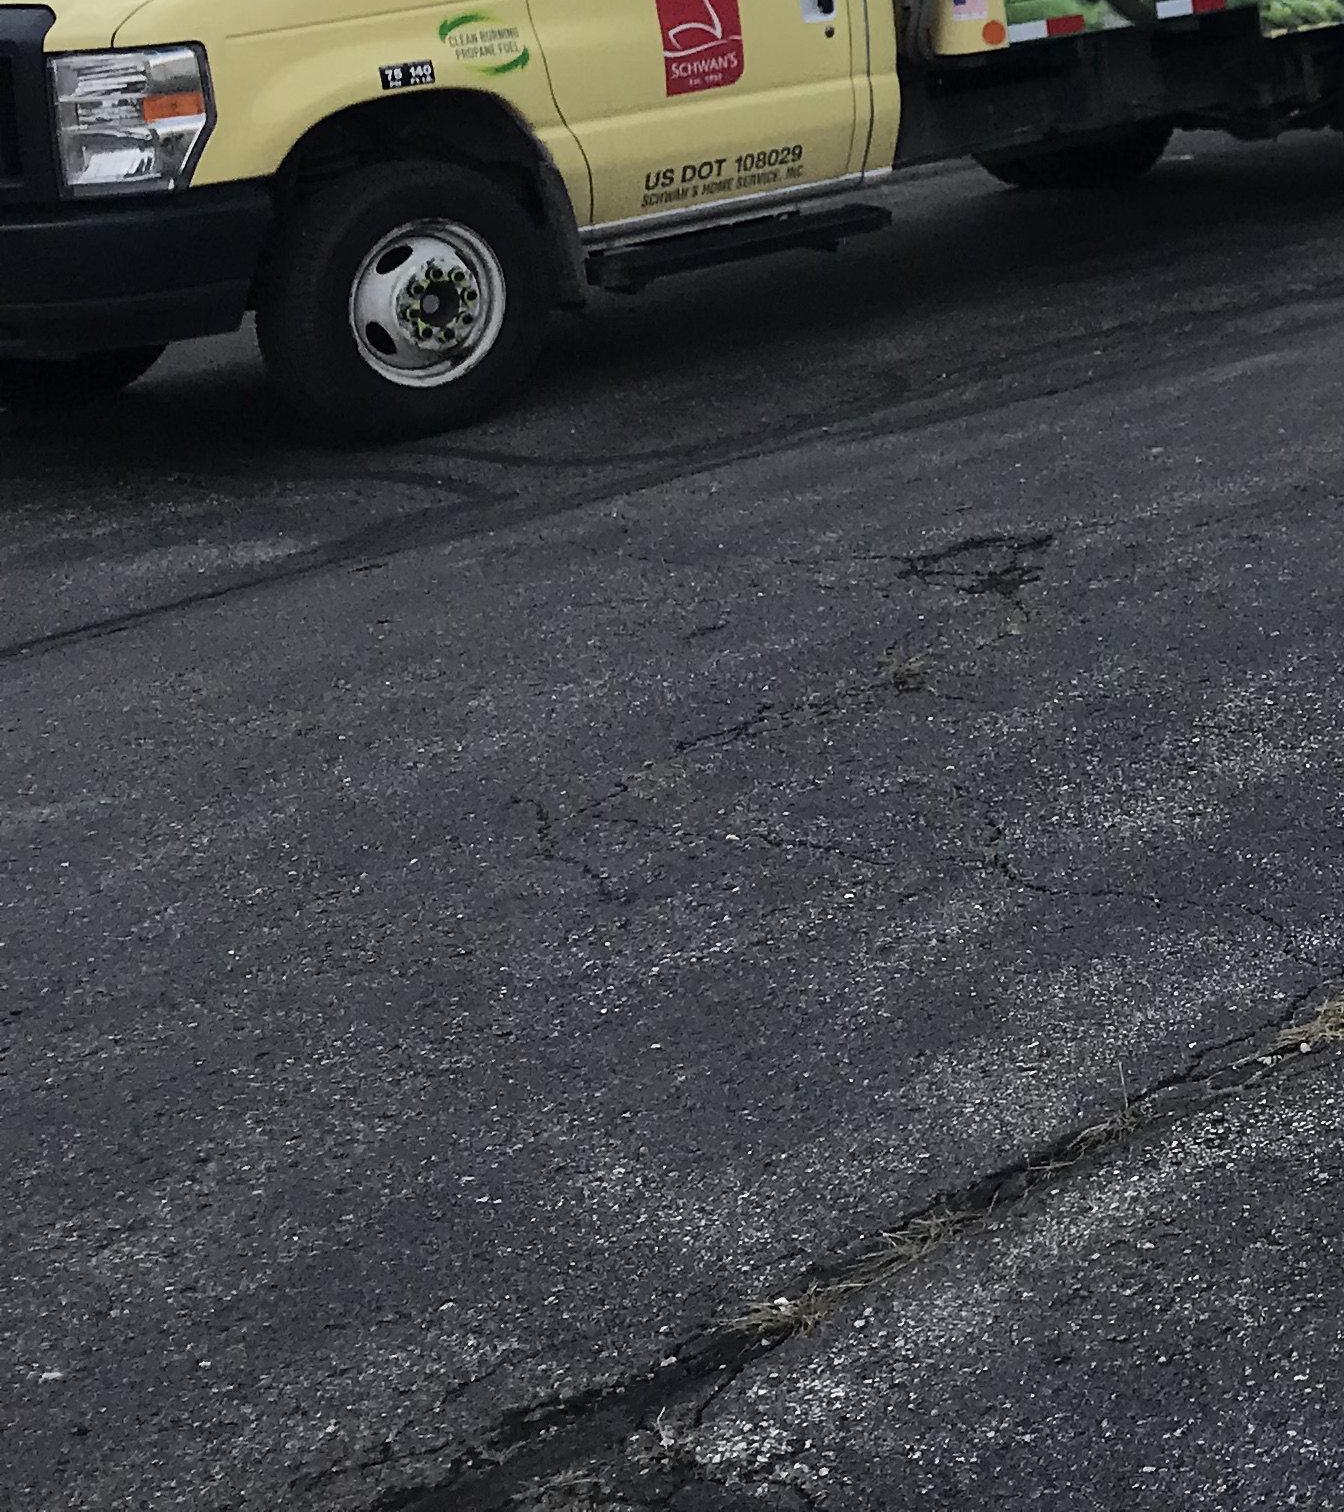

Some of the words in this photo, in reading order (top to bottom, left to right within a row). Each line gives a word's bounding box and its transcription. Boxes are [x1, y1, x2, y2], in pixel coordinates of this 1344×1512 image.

[448, 32, 479, 48] CLEAN
[409, 64, 432, 78] 140
[671, 50, 738, 79] SCHWAN'S
[644, 167, 675, 190] US
[680, 158, 727, 184] DOT
[735, 144, 804, 173] 108029
